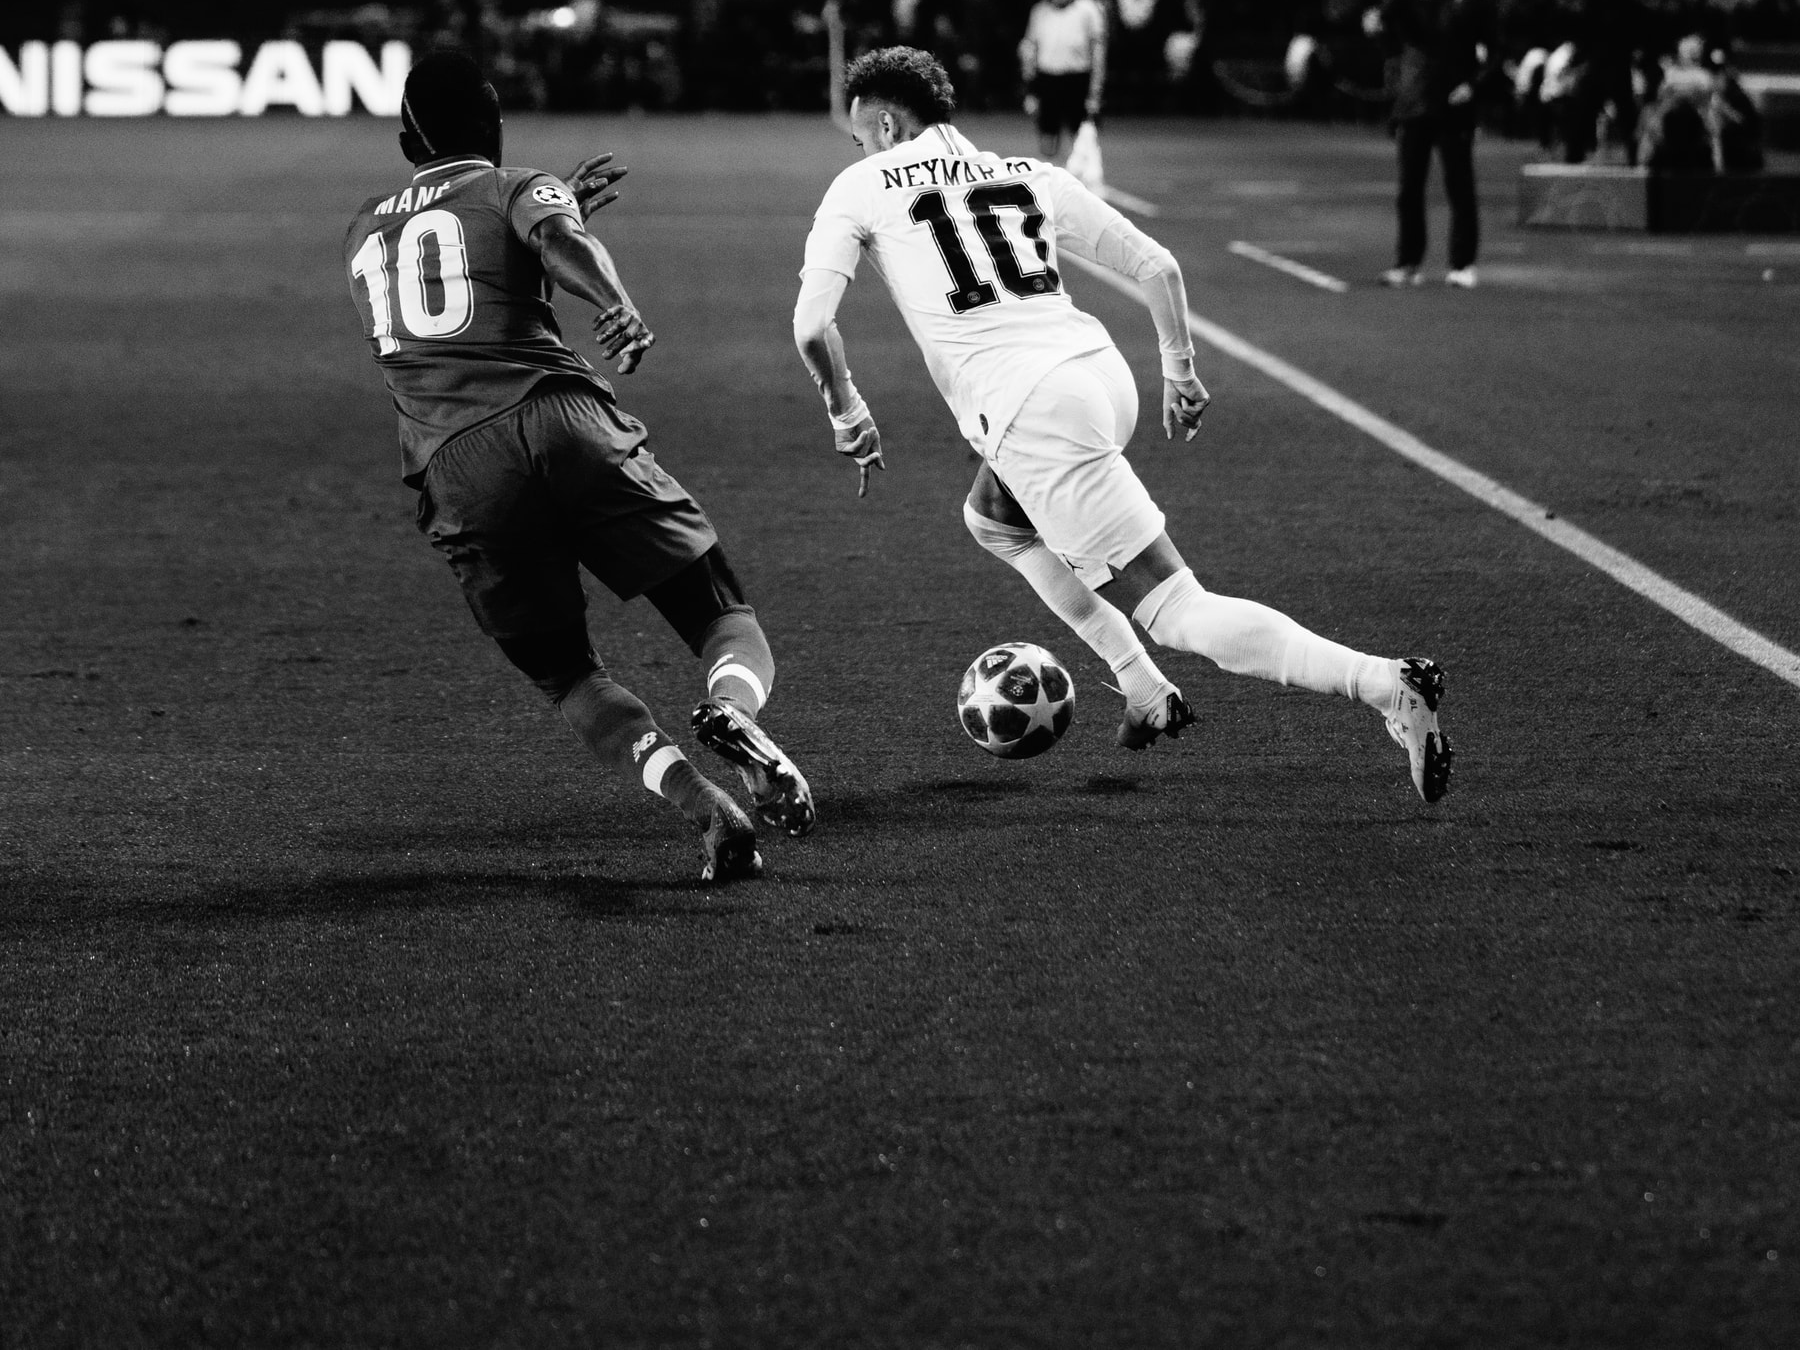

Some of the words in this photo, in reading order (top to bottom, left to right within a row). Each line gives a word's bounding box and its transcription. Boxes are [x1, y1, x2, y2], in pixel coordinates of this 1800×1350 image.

[0, 40, 411, 116] NISSAN
[881, 158, 995, 189] NEYMAR
[351, 209, 474, 356] 10
[908, 181, 1061, 314] 10
